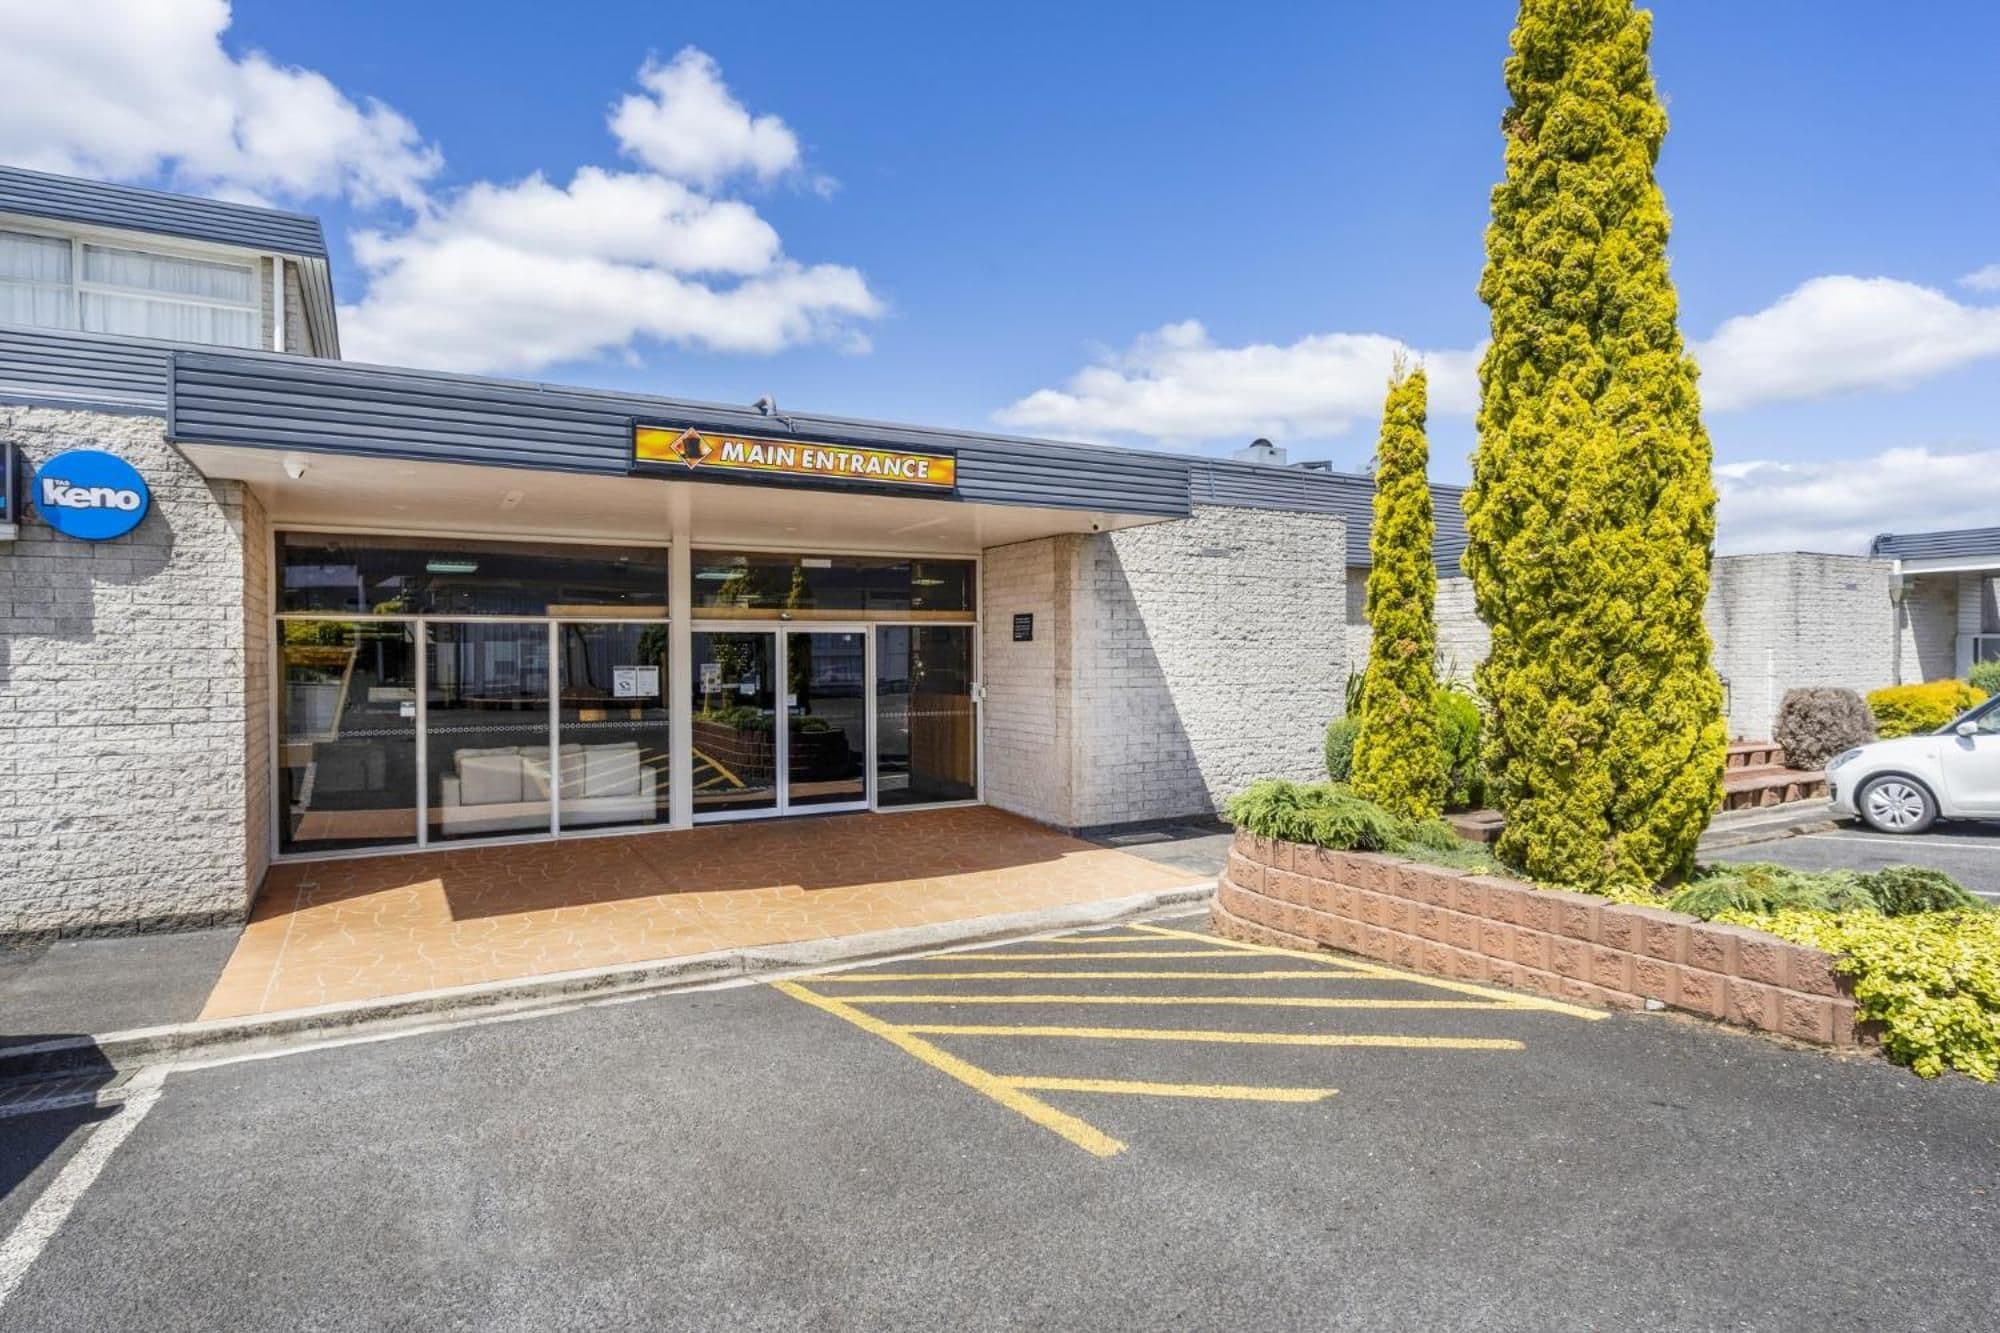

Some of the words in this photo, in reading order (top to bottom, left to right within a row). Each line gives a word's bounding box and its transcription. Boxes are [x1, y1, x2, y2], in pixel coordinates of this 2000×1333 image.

[721, 441, 795, 467] MAIN
[802, 448, 929, 478] ENTRANCE
[42, 478, 140, 511] keno
